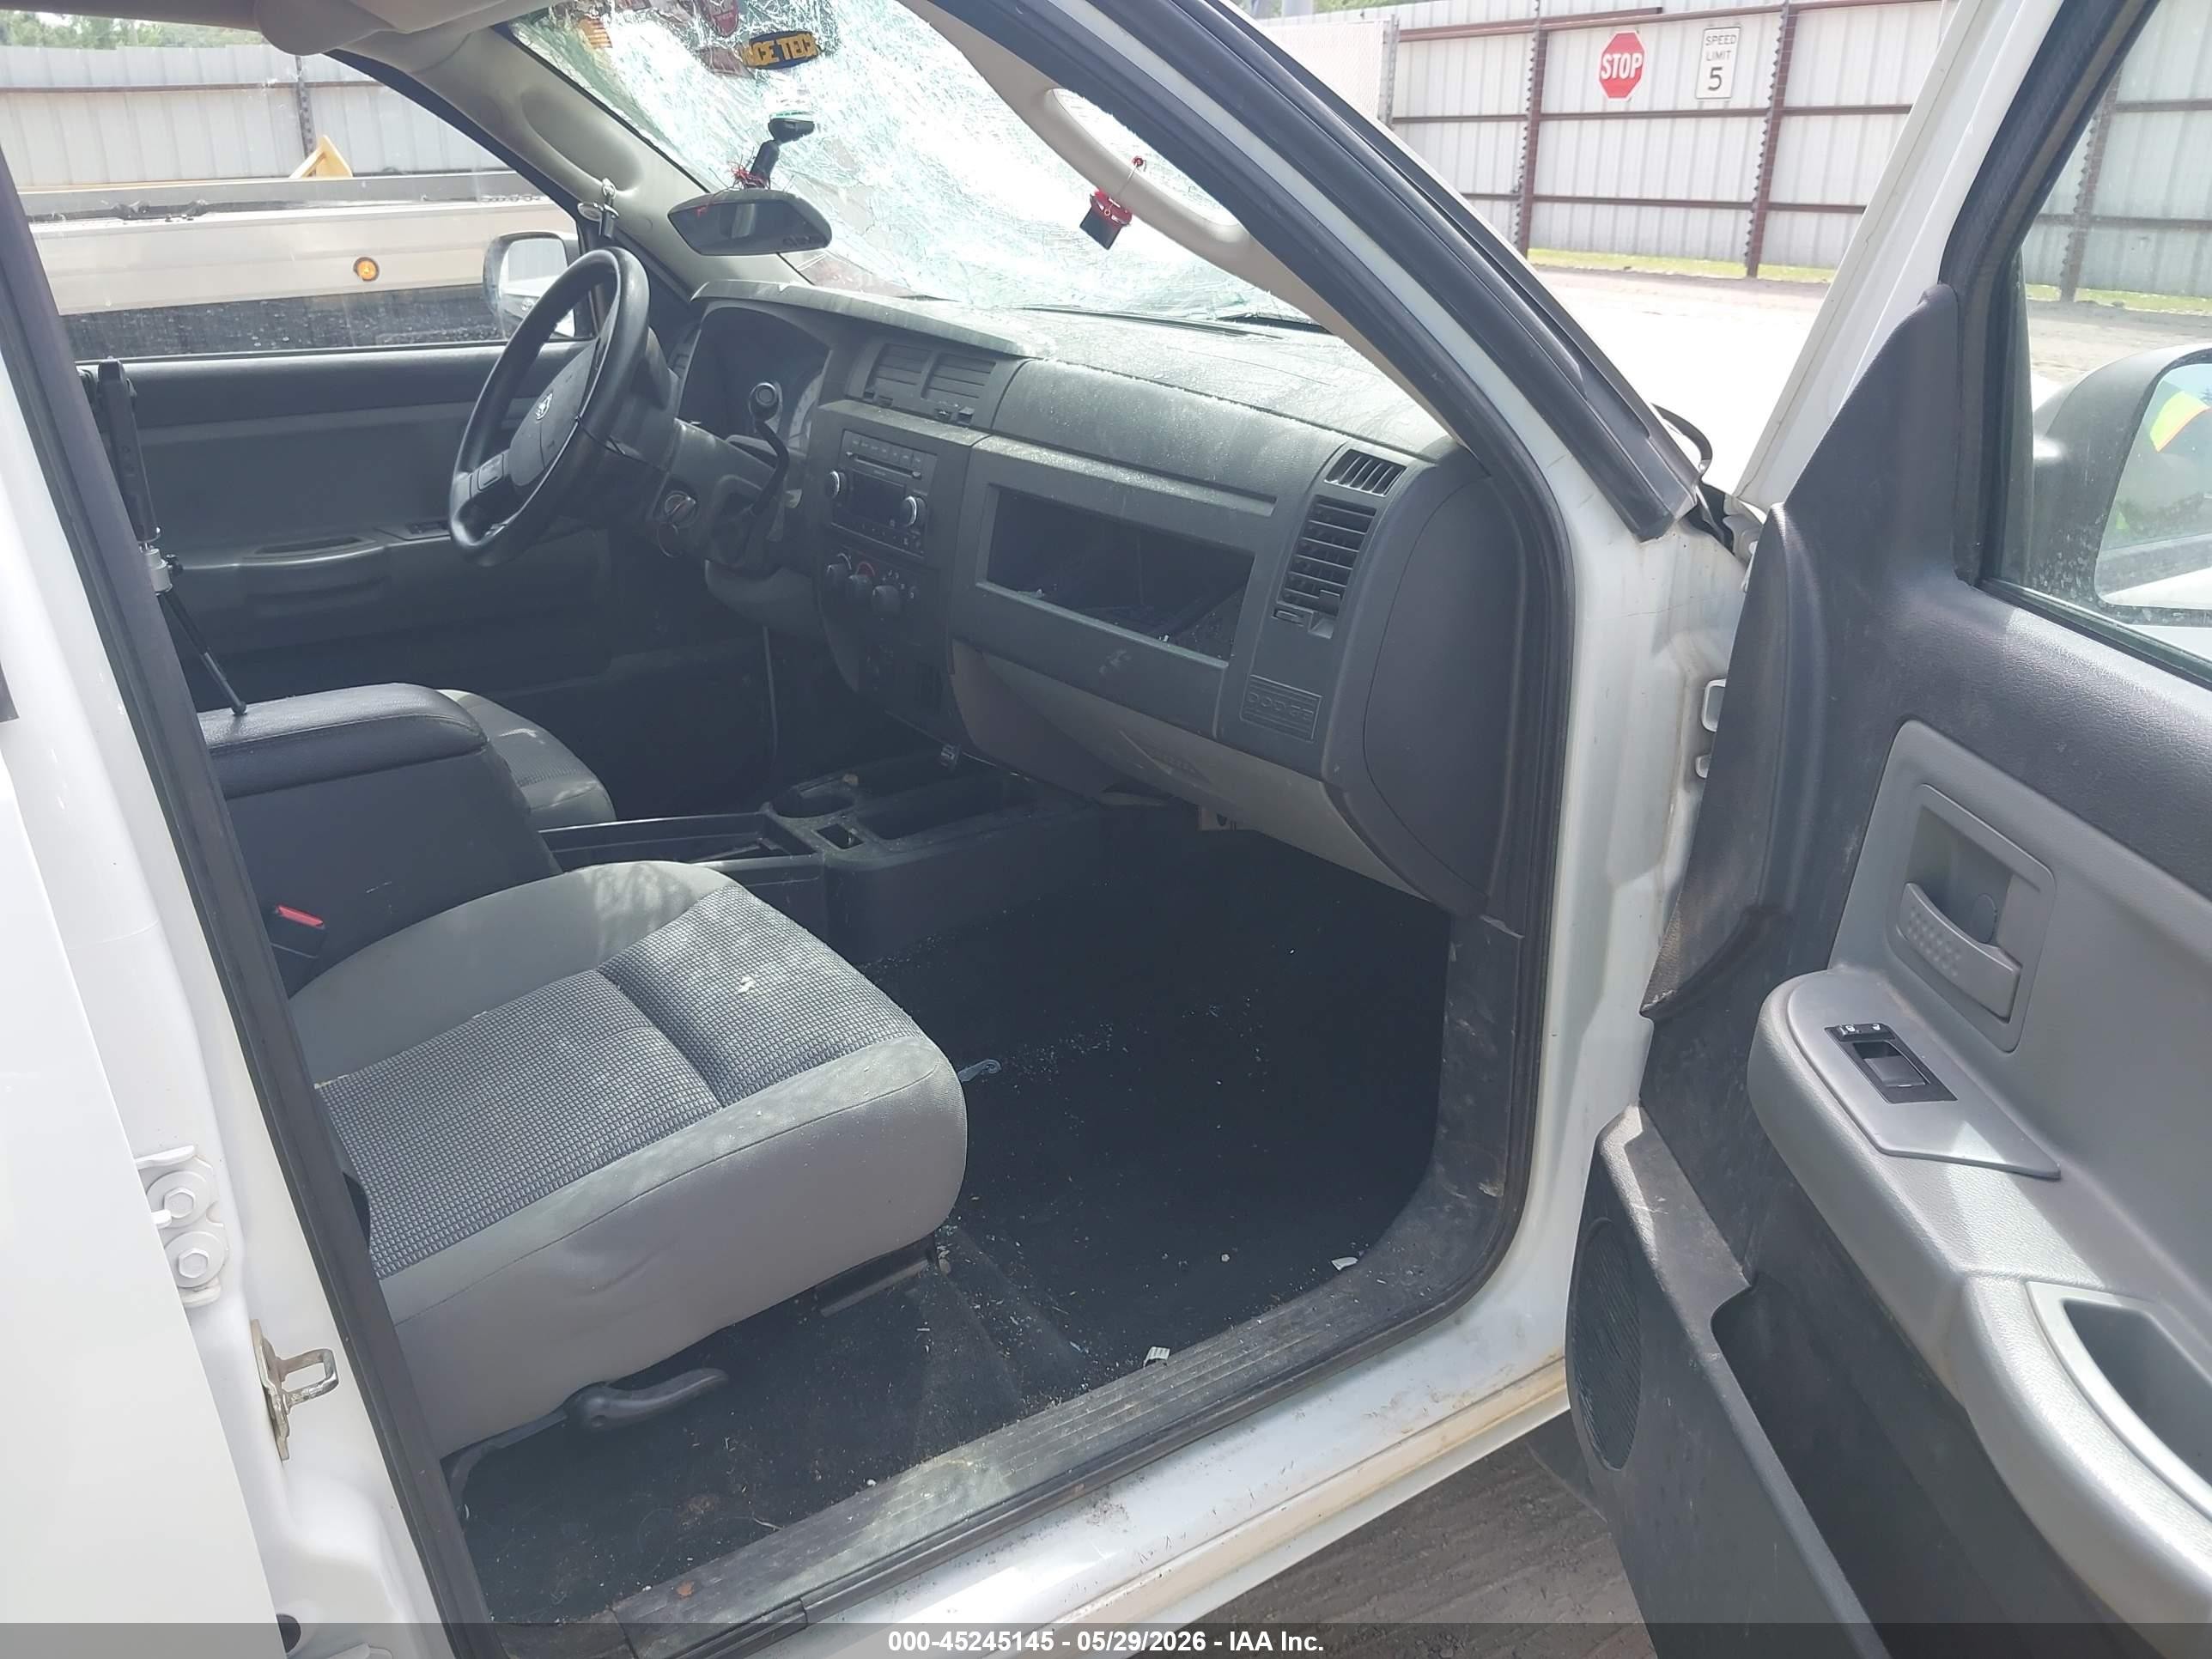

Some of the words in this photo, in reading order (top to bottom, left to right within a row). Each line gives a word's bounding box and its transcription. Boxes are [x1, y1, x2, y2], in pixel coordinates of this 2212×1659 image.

[1705, 34, 1737, 46] SPEED
[1705, 50, 1732, 61] LIMIT
[1601, 52, 1643, 80] STOP
[1707, 66, 1723, 92] 5
